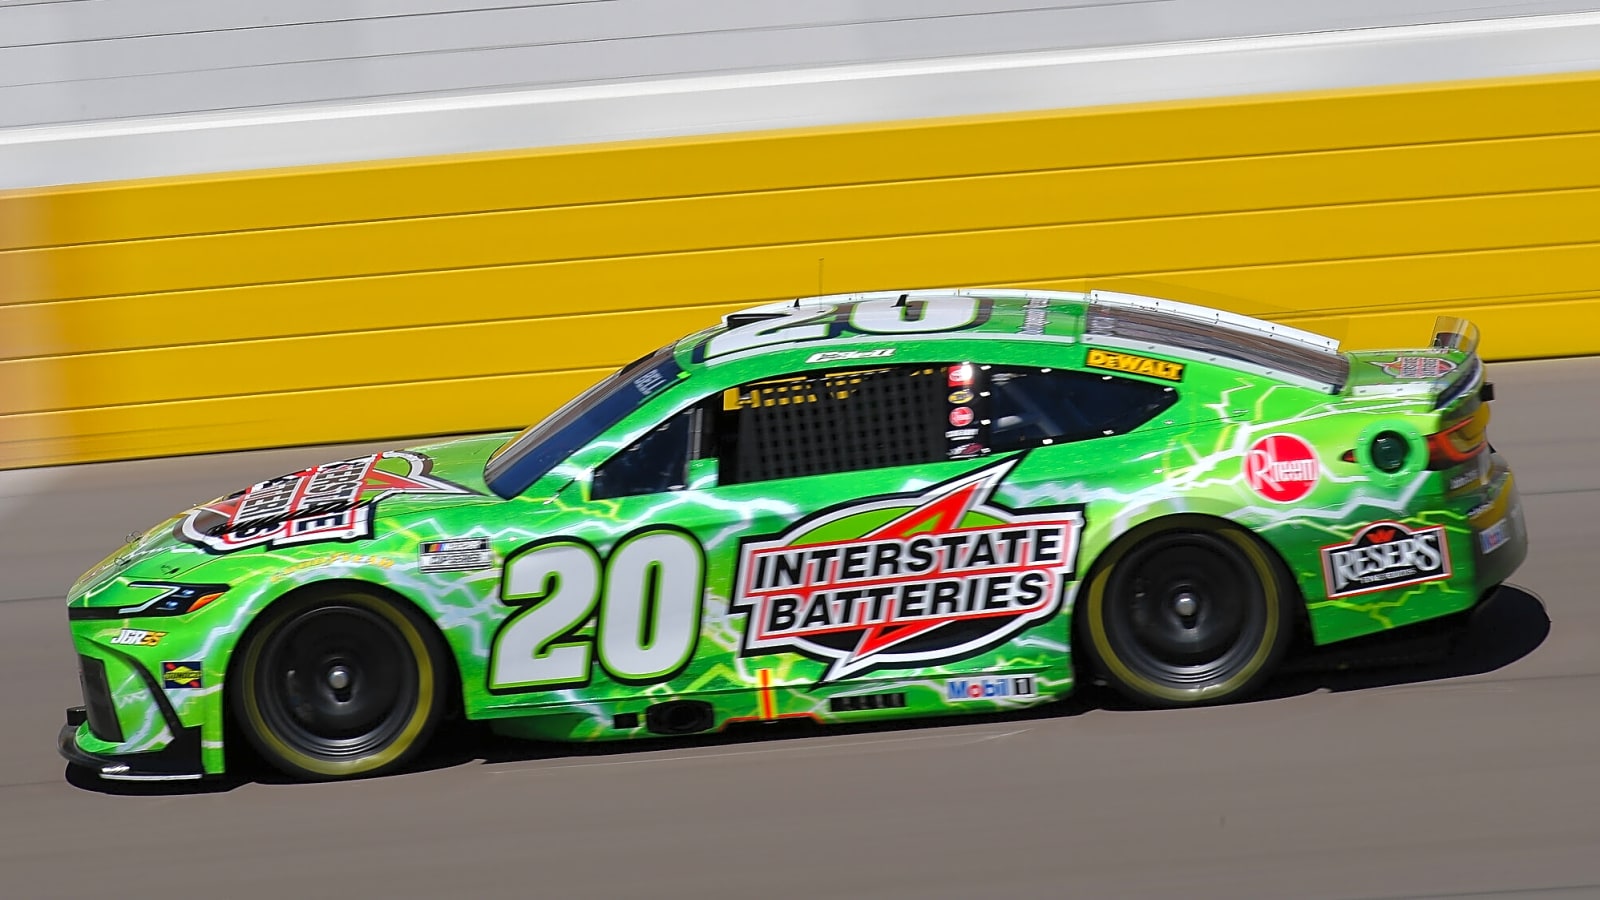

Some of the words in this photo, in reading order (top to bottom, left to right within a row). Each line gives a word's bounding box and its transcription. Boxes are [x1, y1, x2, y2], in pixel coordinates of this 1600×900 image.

[703, 294, 985, 361] 20
[752, 526, 1060, 590] INTERSTATE
[488, 526, 706, 693] 20
[768, 572, 1045, 632] BATTERIES
[948, 678, 1008, 699] Mobil
